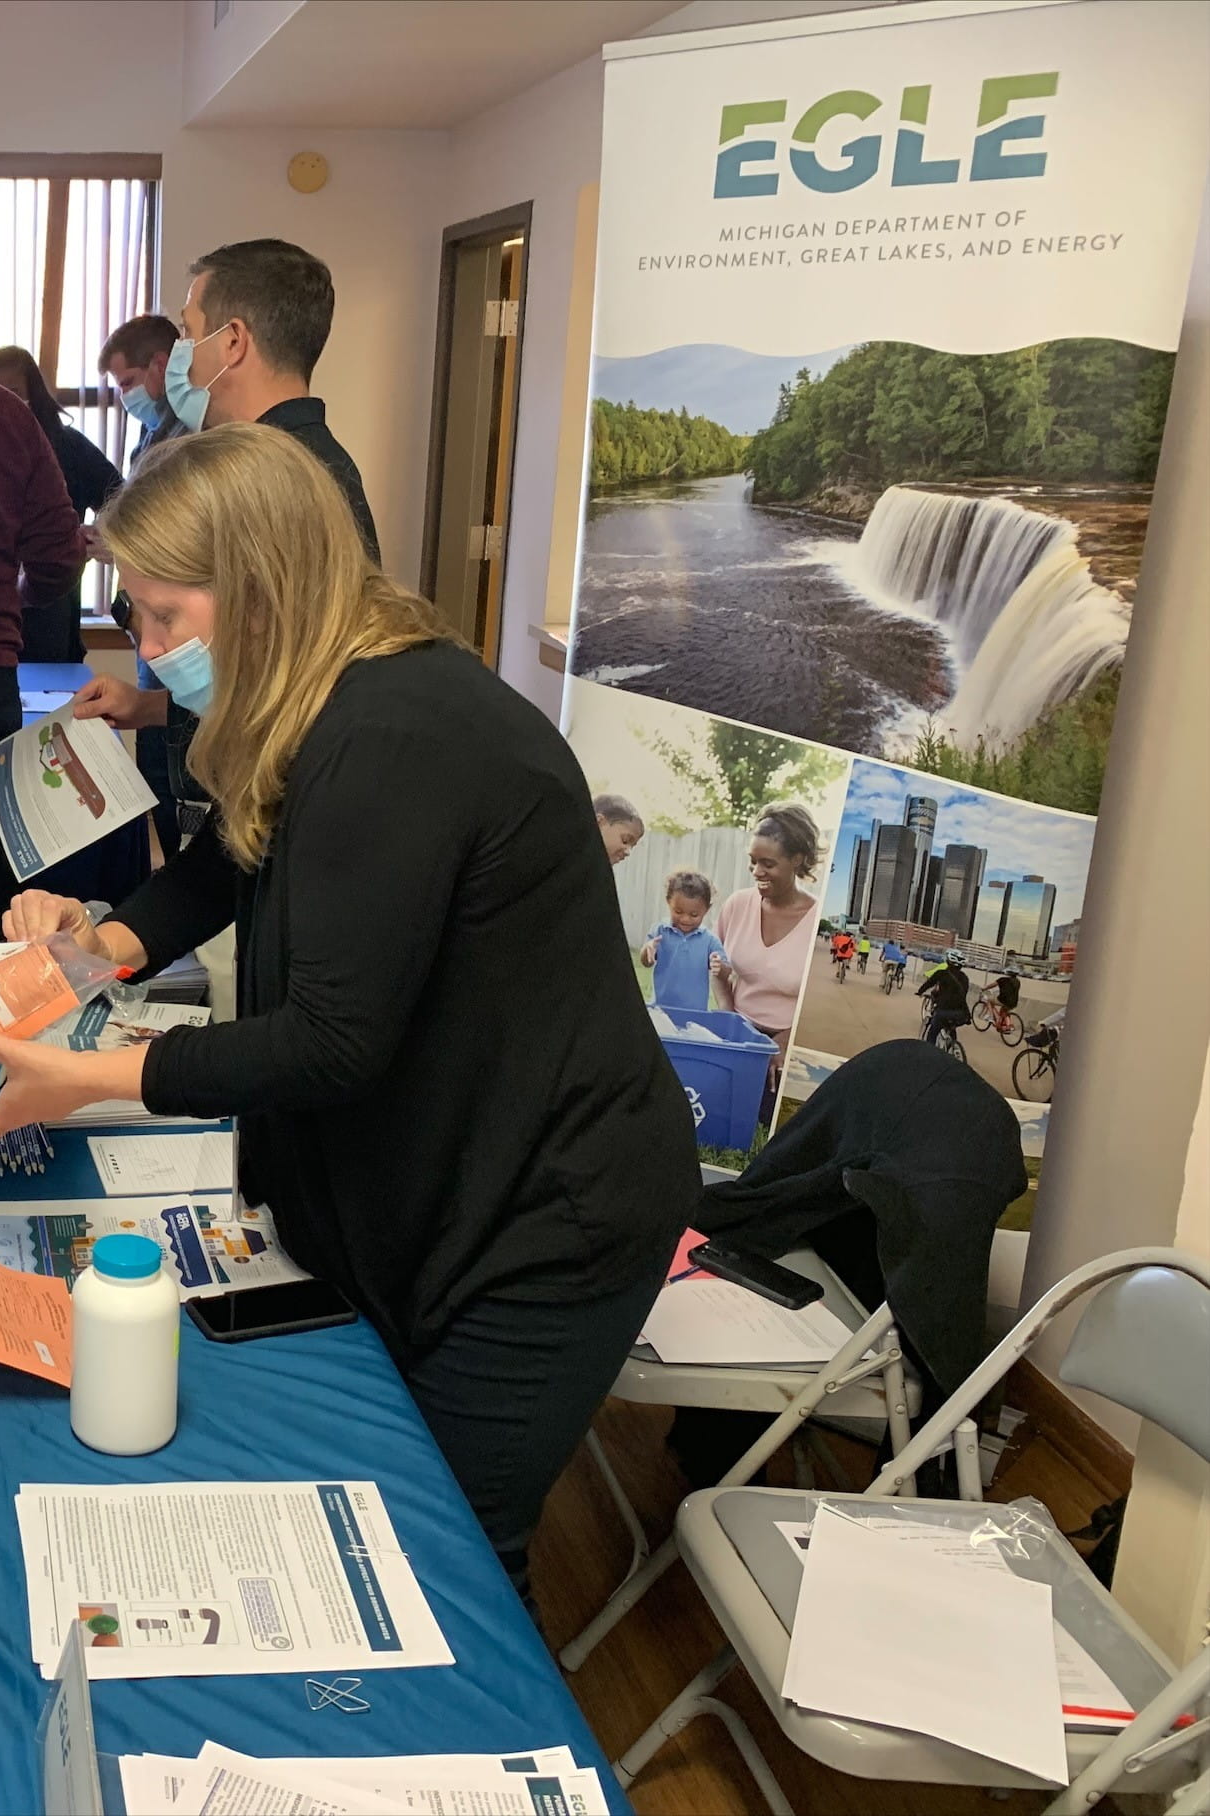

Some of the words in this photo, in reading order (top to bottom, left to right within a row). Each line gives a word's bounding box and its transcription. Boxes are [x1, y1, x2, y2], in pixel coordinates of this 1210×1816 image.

[713, 71, 1059, 199] EGLE
[638, 249, 792, 271] ENVIRONMENT,
[800, 245, 869, 265] GREAT
[878, 242, 952, 262] LAKES,
[962, 239, 1012, 257] AND
[1022, 233, 1124, 255] ENERGY
[719, 221, 826, 242] MICHIGAN
[835, 212, 986, 236] DEPARTMENT
[995, 210, 1027, 227] OF
[353, 1492, 368, 1511] EGLE
[358, 1563, 370, 1582] AFFECT
[365, 1582, 374, 1596] YOUR
[379, 1622, 391, 1640] WATER
[58, 1692, 72, 1768] EGLE
